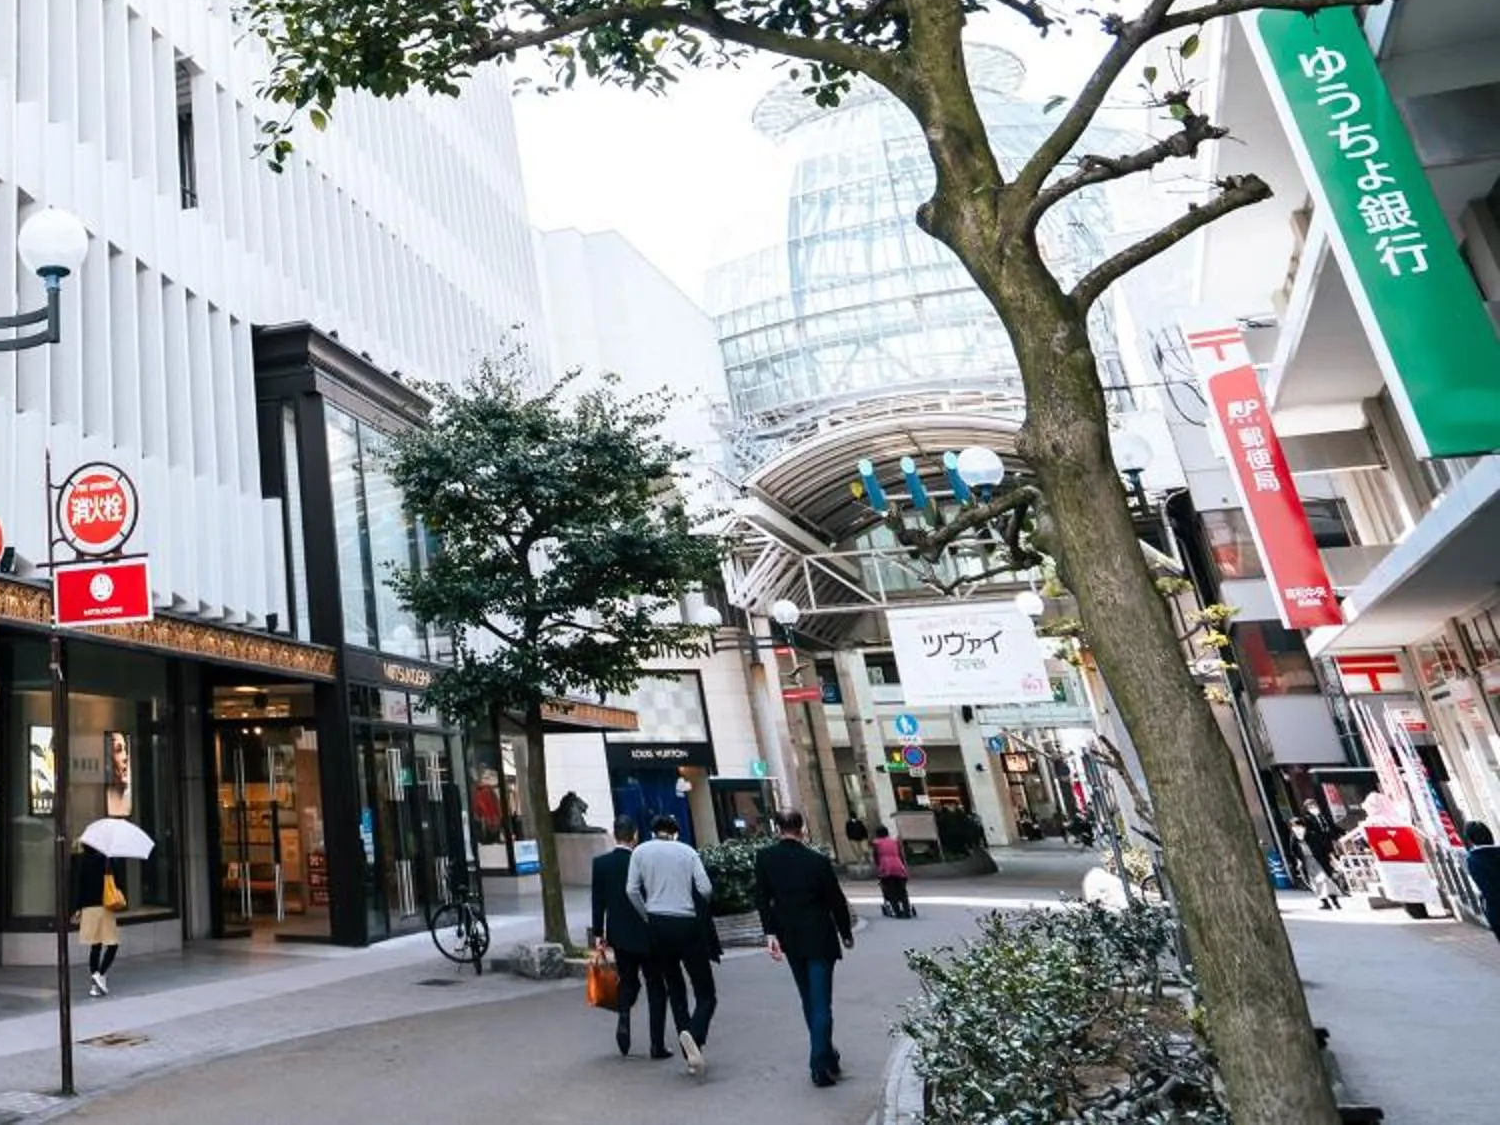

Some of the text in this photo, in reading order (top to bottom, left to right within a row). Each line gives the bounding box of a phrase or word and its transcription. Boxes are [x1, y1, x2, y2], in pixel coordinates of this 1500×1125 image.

[1297, 45, 1430, 277] ゆうちょ銀行
[1237, 426, 1281, 492] 郵便局
[70, 492, 123, 526] 消火栓
[921, 629, 1003, 658] ツヴァイ
